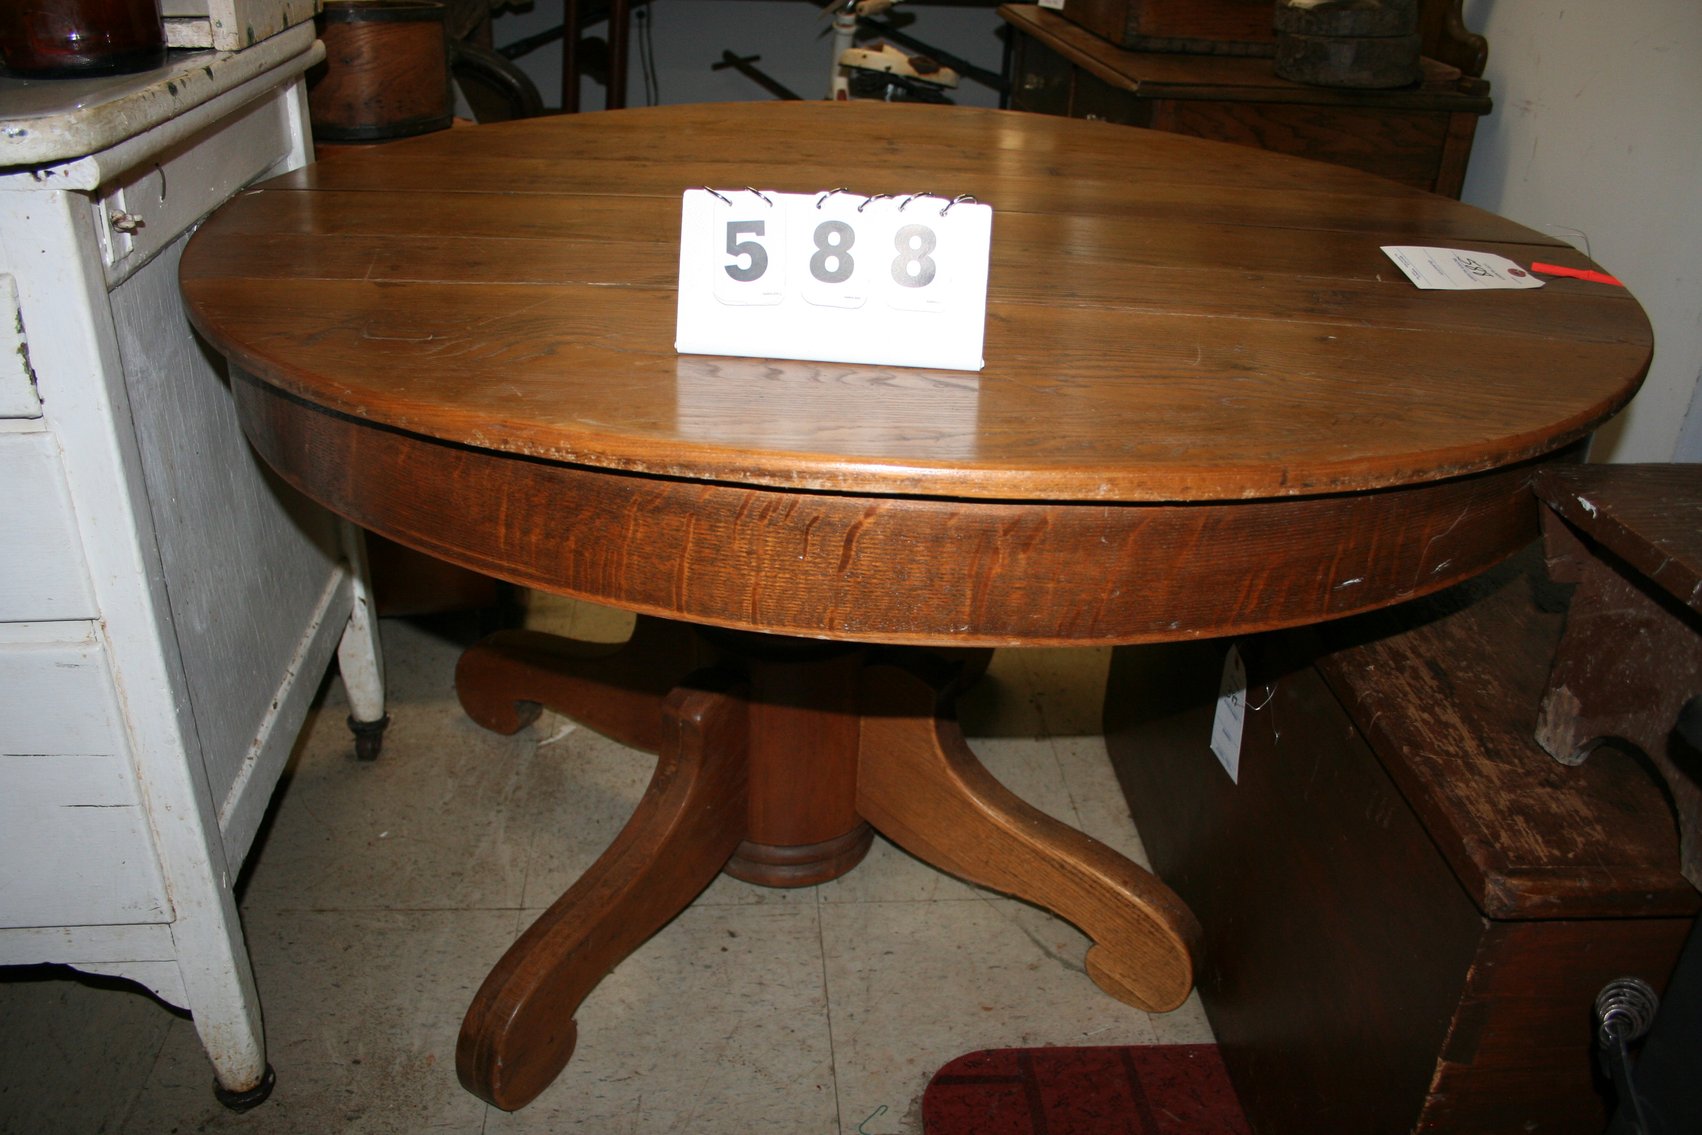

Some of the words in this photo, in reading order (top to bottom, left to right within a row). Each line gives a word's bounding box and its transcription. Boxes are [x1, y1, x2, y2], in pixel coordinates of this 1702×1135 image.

[724, 219, 769, 283] 5
[809, 219, 856, 284] 8
[891, 222, 937, 289] 8
